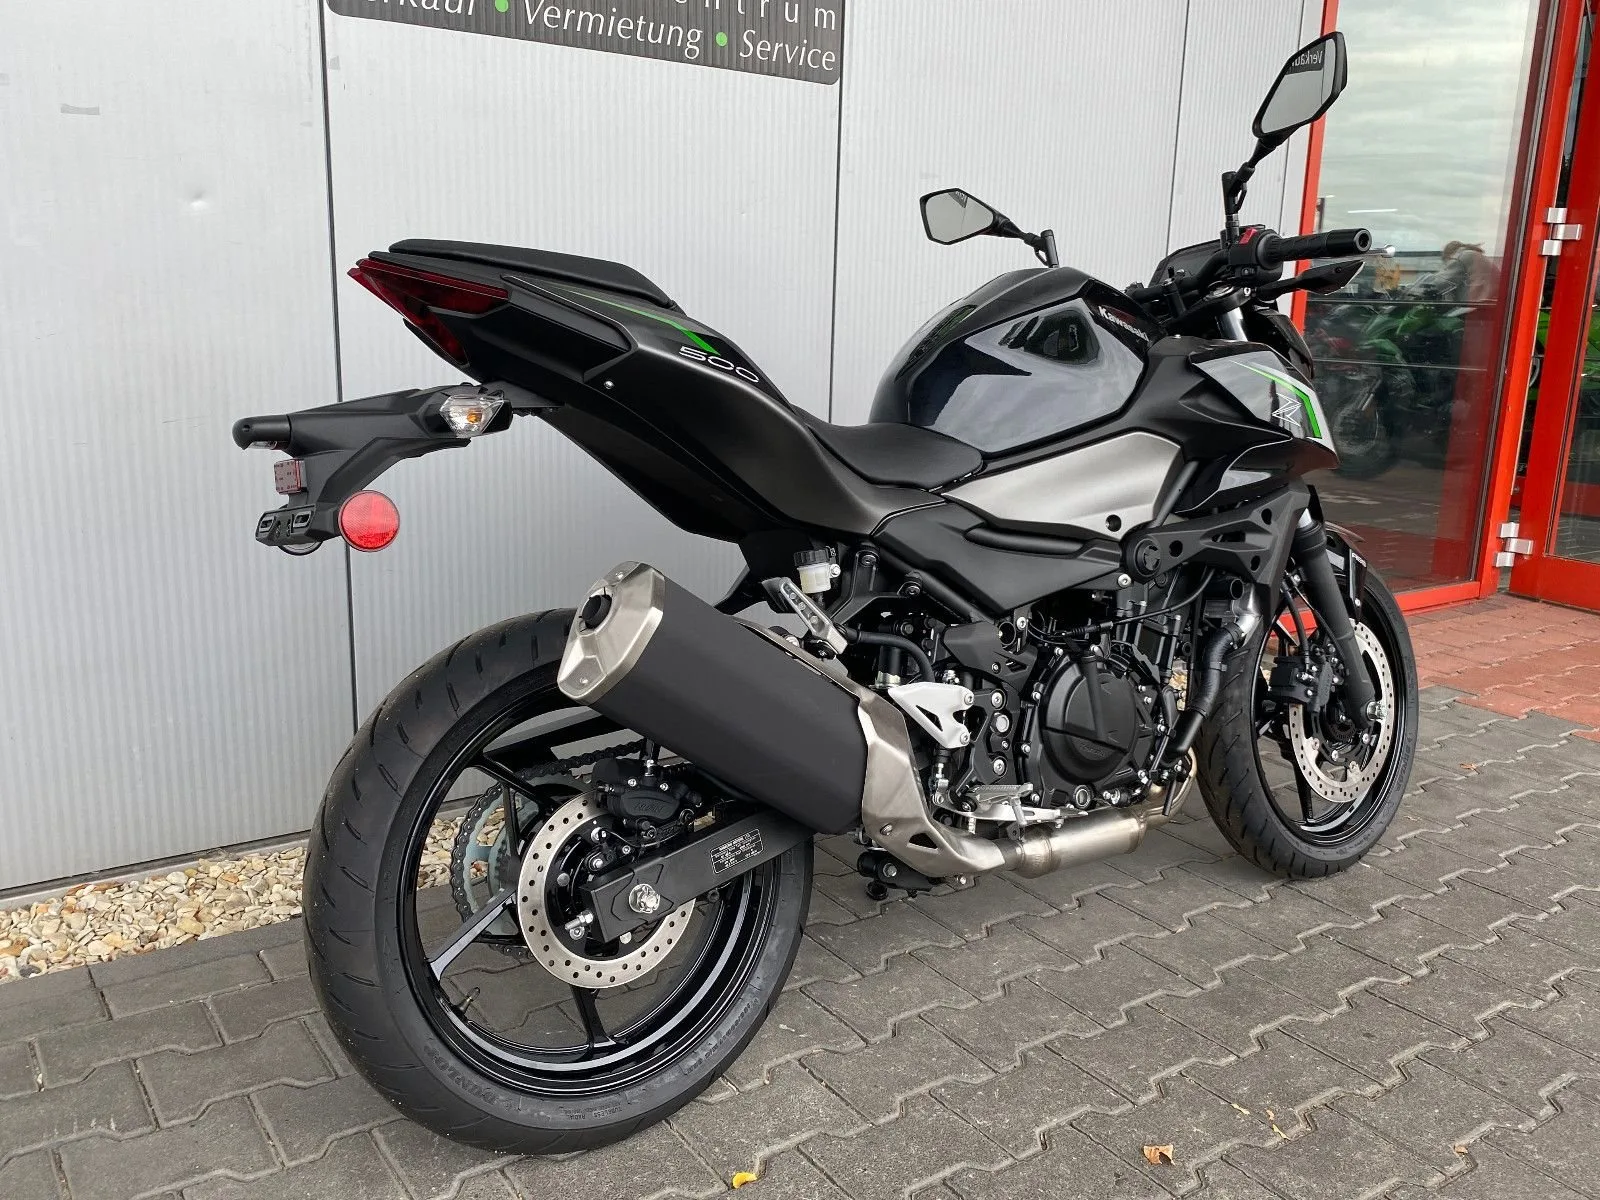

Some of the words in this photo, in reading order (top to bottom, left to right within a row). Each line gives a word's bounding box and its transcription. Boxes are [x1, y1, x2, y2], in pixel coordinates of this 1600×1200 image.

[523, 0, 703, 60] Vermietung
[739, 29, 836, 71] Service
[1098, 305, 1150, 342] Kawasaki
[679, 345, 760, 383] 500
